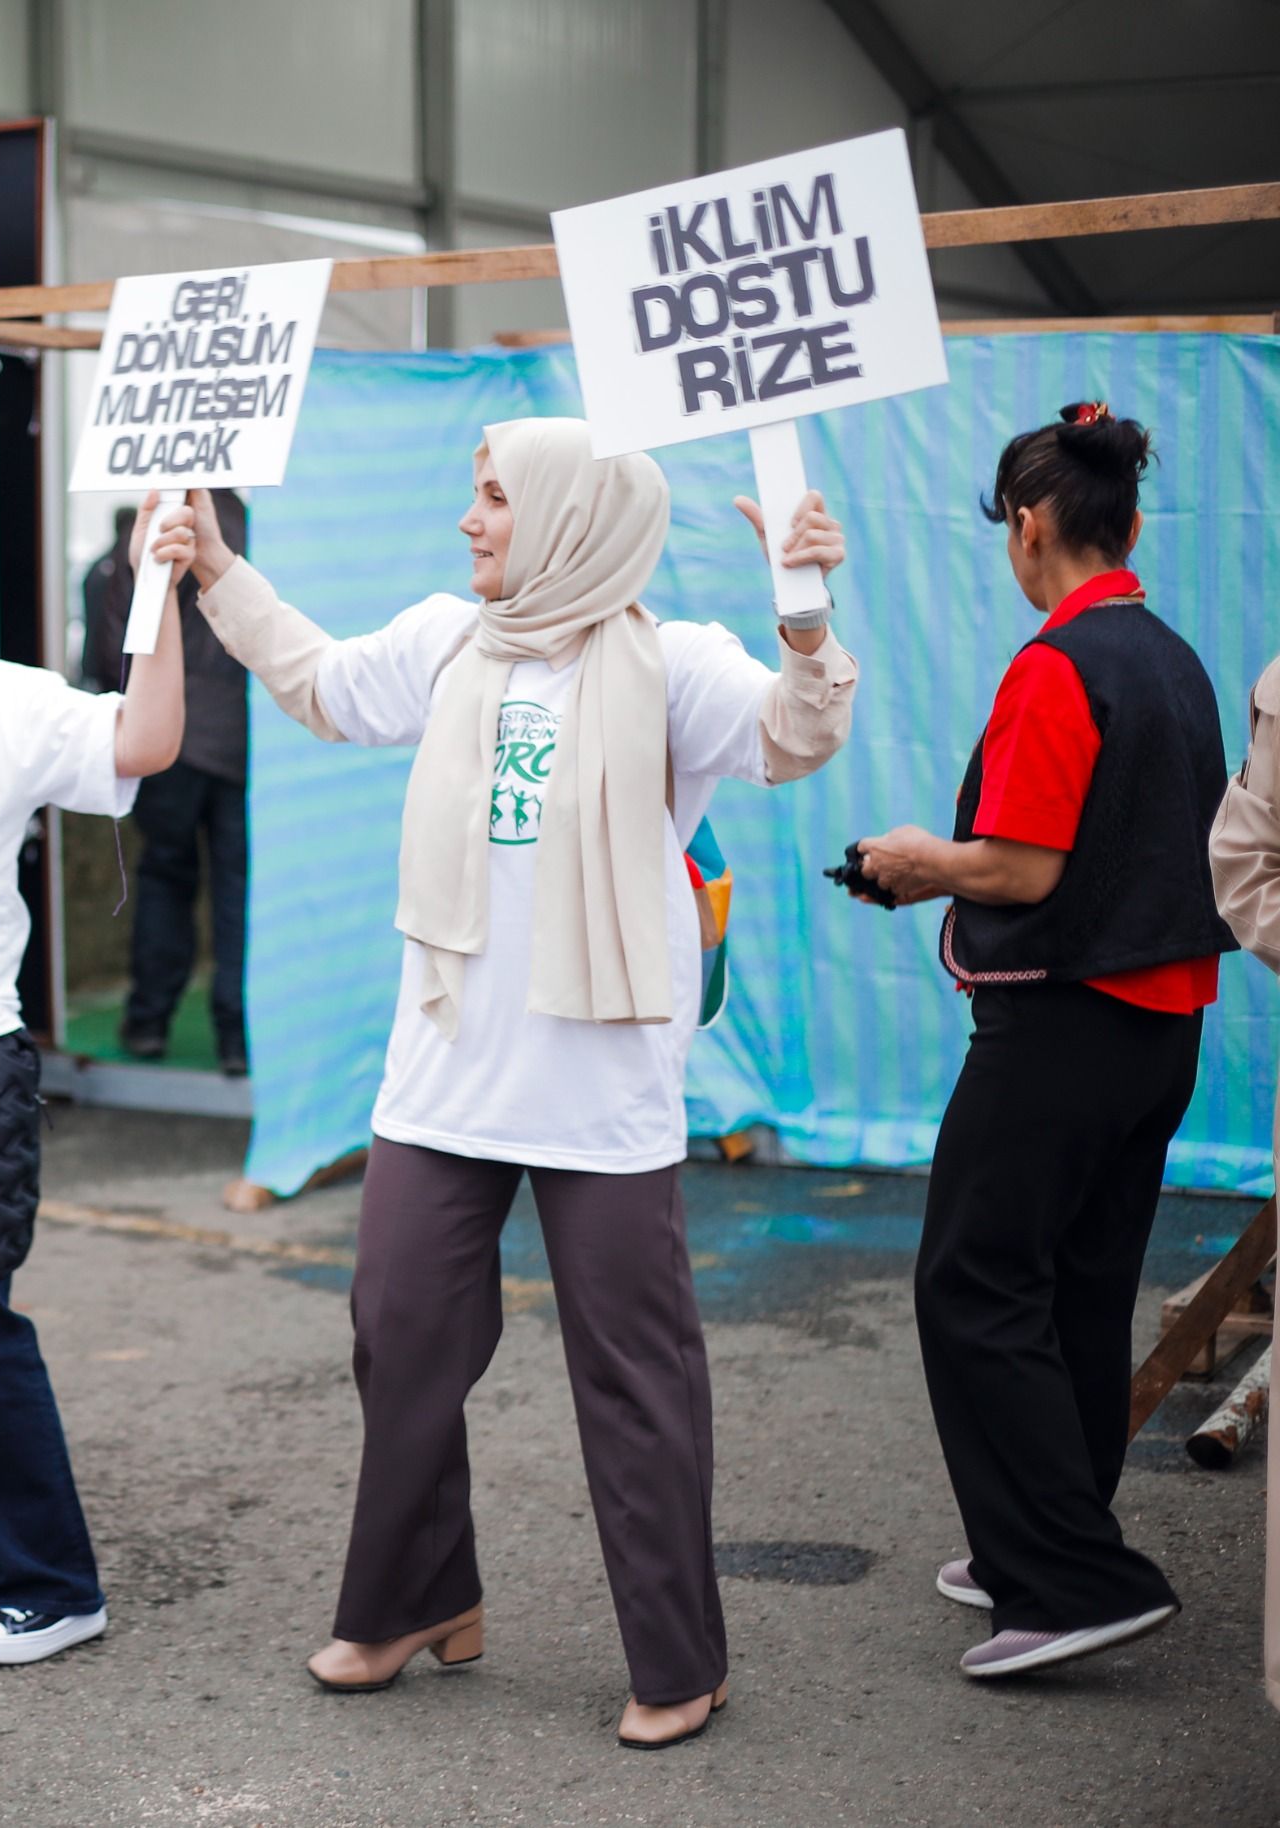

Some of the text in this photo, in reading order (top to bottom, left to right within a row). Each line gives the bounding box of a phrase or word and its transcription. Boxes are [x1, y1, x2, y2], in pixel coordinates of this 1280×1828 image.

[648, 172, 843, 275] İKLİM
[172, 271, 249, 322] GERİ
[631, 236, 875, 353] DOSTU
[676, 320, 864, 415] RİZE
[107, 428, 240, 476] OLACAK
